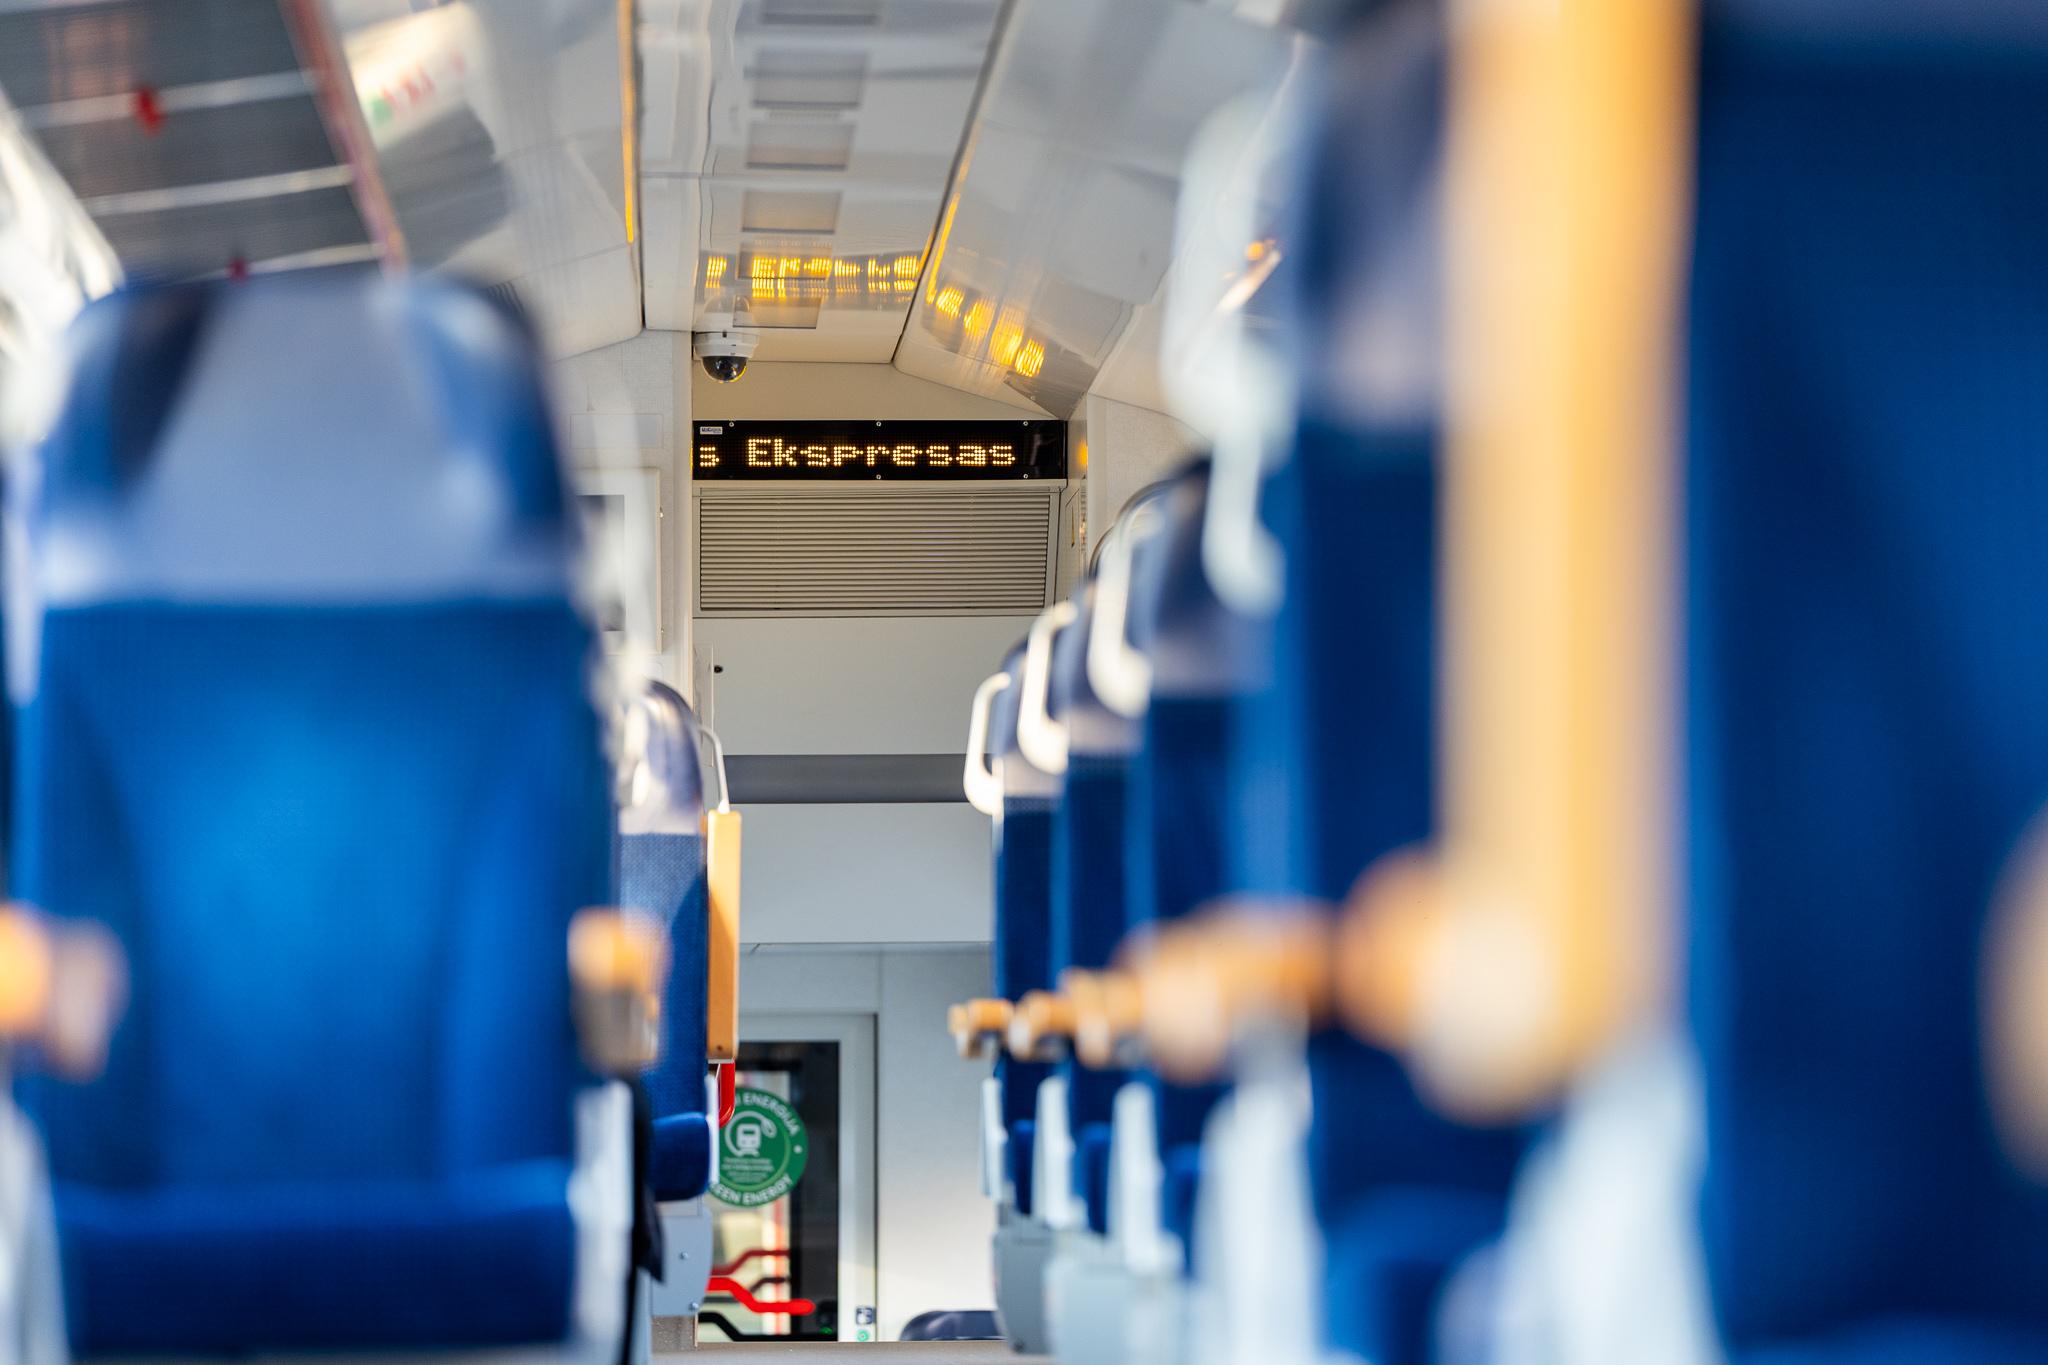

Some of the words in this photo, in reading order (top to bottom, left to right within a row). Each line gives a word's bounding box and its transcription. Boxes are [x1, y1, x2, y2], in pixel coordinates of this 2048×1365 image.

[699, 446, 720, 467] s
[747, 438, 1016, 467] Ekspresas
[742, 1172, 793, 1206] ENERGY
